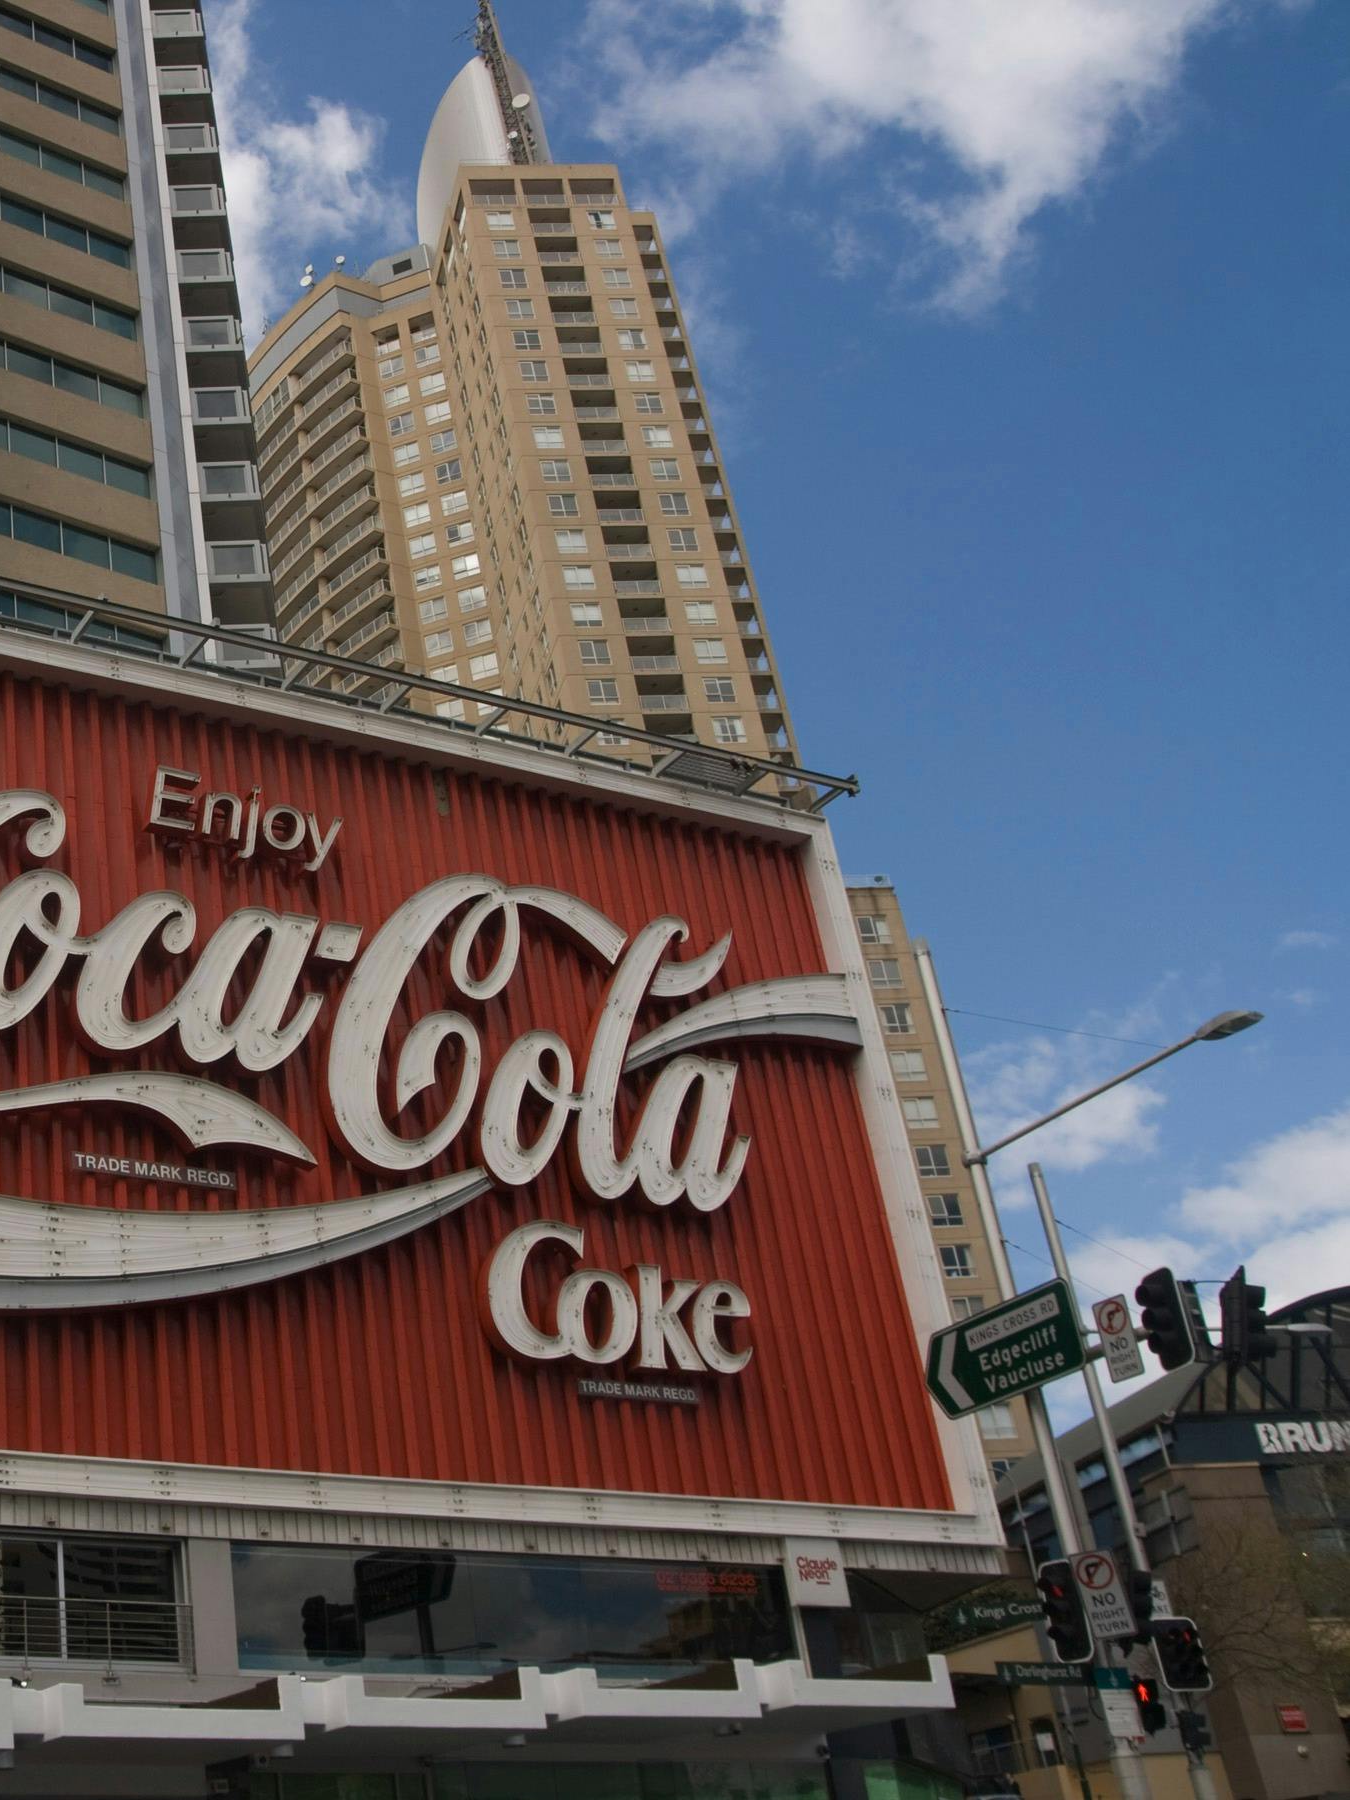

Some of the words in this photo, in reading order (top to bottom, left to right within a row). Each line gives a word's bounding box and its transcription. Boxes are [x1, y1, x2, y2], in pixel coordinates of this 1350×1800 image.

[148, 765, 344, 872] Enjoy
[75, 1153, 130, 1174] TRADE
[135, 1162, 182, 1180] MARK
[187, 1168, 234, 1187] REGD.
[488, 1220, 753, 1374] Coke
[969, 1323, 999, 1345] KINGS
[1002, 1308, 1036, 1331] CROSS
[978, 1324, 1058, 1371] Edgecliff
[1109, 1336, 1129, 1353] NO
[984, 1352, 1065, 1393] Vaucluse
[581, 1380, 622, 1395] TRADE
[625, 1384, 660, 1398] MARK
[796, 1556, 838, 1570] Claude
[1091, 1592, 1116, 1607] NO
[974, 1607, 1005, 1620] Kings
[1008, 1603, 1043, 1615] Cross
[1091, 1608, 1126, 1620] RIGHT
[1097, 1620, 1130, 1633] TURN
[1016, 1664, 1067, 1681] Darlinghurst
[1069, 1663, 1083, 1678] Rd
